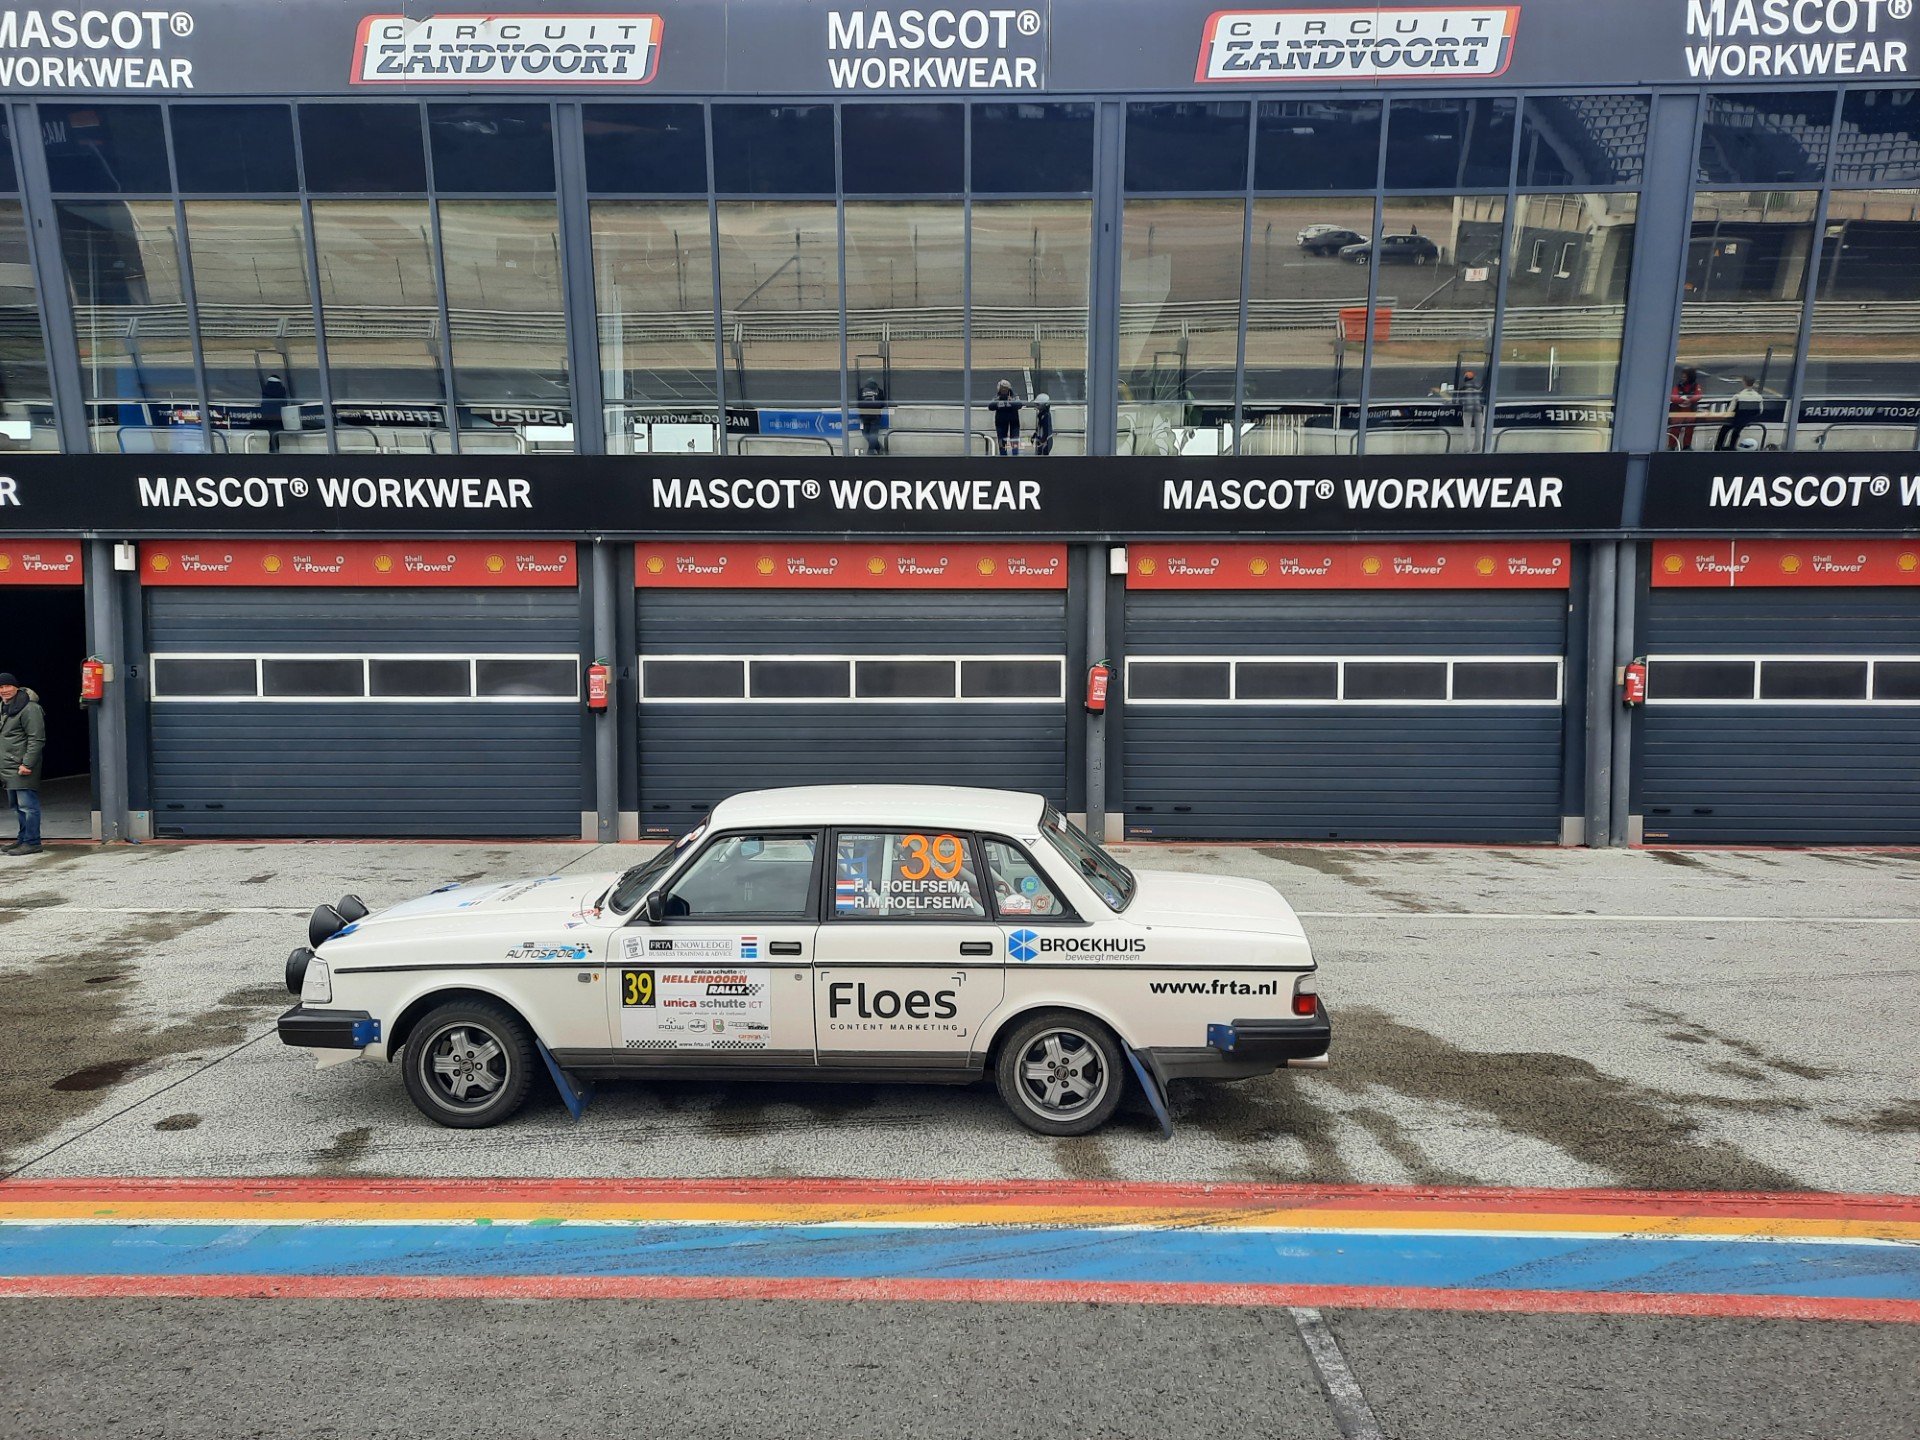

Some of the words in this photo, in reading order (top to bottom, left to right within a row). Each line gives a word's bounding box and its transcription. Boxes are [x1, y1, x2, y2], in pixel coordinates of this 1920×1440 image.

[382, 24, 638, 40] CIRCUIT
[827, 10, 1040, 50] MASCOT®
[1230, 18, 1493, 37] CIRCUIT
[376, 43, 635, 75] ZANDVOORT
[1225, 36, 1489, 71] ZANDVOORT
[1685, 41, 1908, 77] WORKWEAR
[827, 57, 1038, 89] WORKWEAR
[137, 477, 309, 508] MASCOT®
[316, 478, 533, 508] WORKWEAR
[652, 478, 821, 509] MASCOT®
[828, 480, 1042, 510] WORKWEAR
[1162, 479, 1336, 510] MASCOT®
[1344, 477, 1565, 509] WORKWEAR
[1709, 475, 1891, 507] MASCOT®
[676, 556, 694, 564] Shell
[1393, 556, 1412, 564] Shell
[22, 562, 70, 572] V-Power
[181, 562, 229, 572] V-Power
[293, 563, 341, 574] V-Power
[404, 562, 453, 572] V-Power
[516, 562, 564, 572] V-Power
[676, 564, 724, 574] V-Power
[787, 565, 834, 576] V-Power
[897, 565, 945, 576] V-Power
[1008, 565, 1055, 576] V-Power
[1168, 565, 1216, 576] V-Power
[1280, 565, 1328, 576] V-Power
[1393, 564, 1442, 574] V-Power
[1508, 565, 1557, 576] V-Power
[1813, 562, 1862, 573] V-Power
[900, 834, 964, 880] 39
[880, 880, 970, 893] ROELFSEMA
[674, 941, 731, 950] KNOWLEDGE
[1040, 938, 1146, 952] BROEKHUIS
[505, 948, 584, 960] AUTOSPORT
[1065, 952, 1105, 962] beweegt
[1106, 953, 1140, 961] mensen
[662, 974, 748, 983] HELLENDOORN
[625, 972, 653, 1005] 39
[1149, 979, 1278, 996] www.frta.nl
[663, 998, 697, 1008] unica
[699, 998, 747, 1009] schutte
[748, 1000, 763, 1009] ICT
[829, 982, 958, 1020] Floes
[830, 1023, 884, 1031] CONTENT
[890, 1023, 958, 1031] MARKETING
